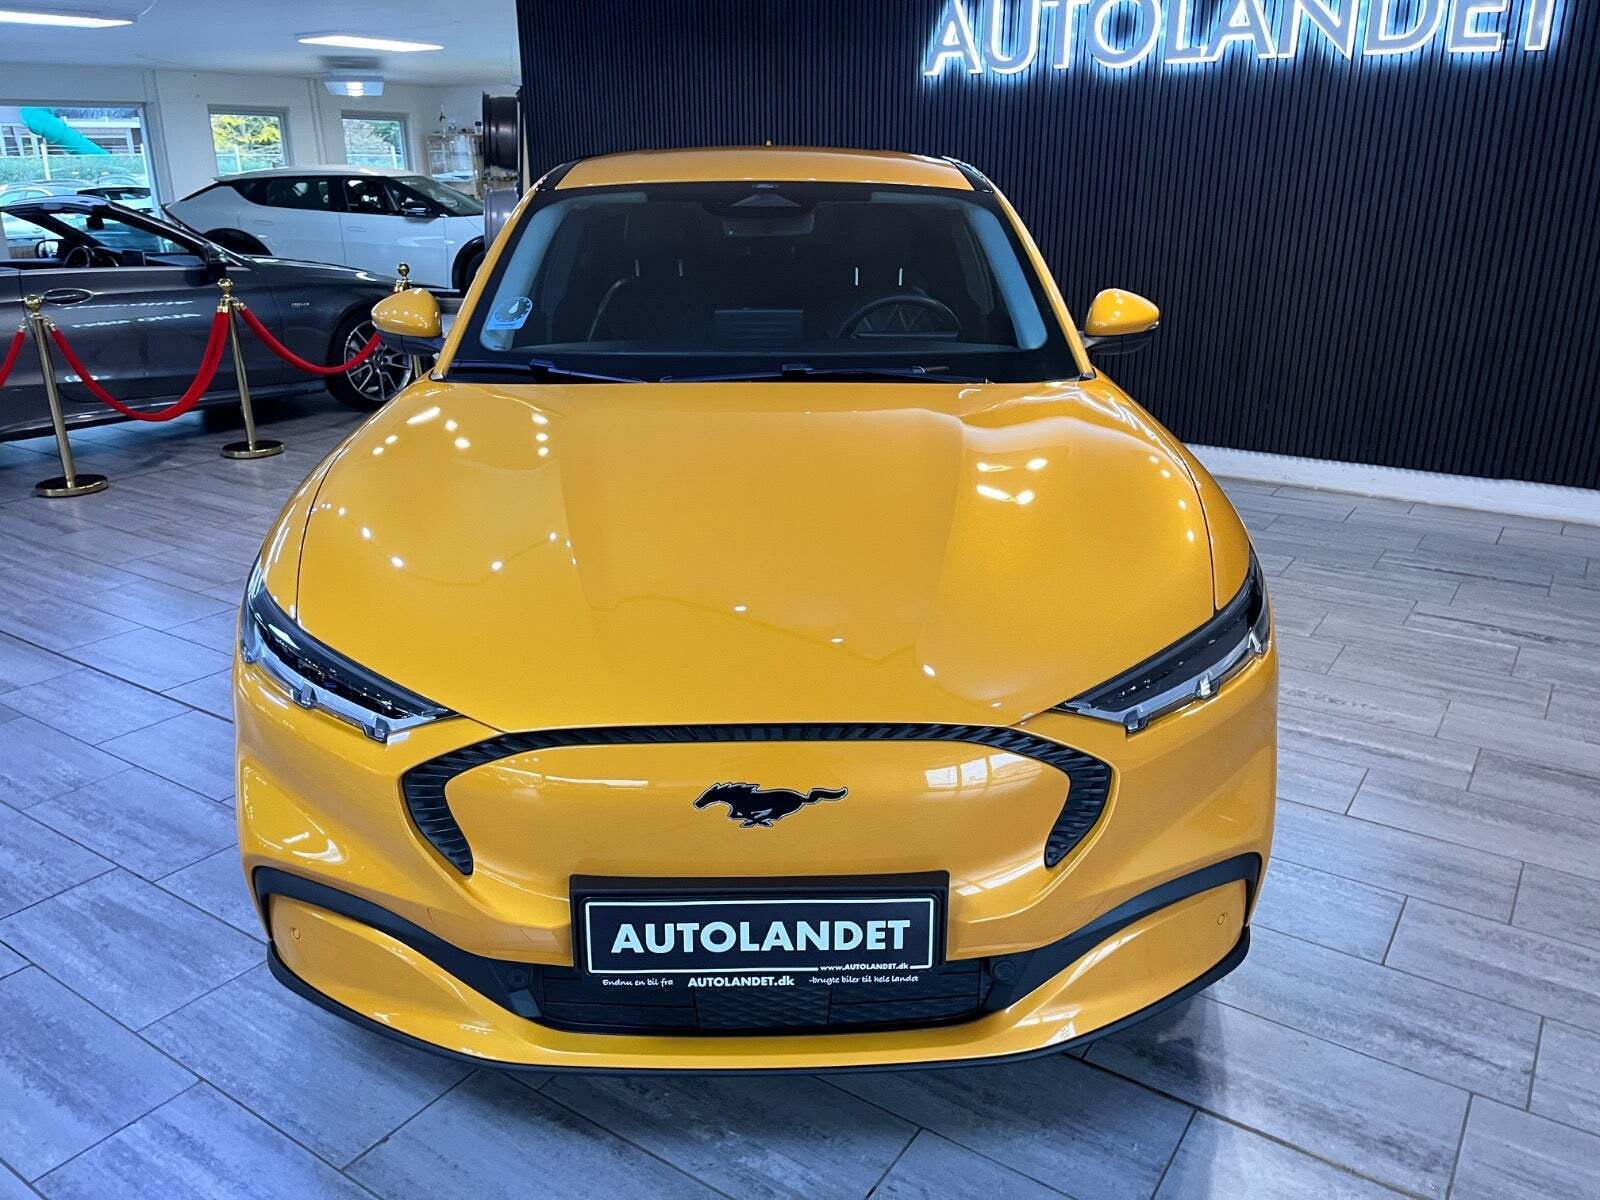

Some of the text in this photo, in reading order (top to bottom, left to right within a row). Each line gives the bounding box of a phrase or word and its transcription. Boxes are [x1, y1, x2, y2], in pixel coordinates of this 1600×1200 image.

[611, 920, 910, 953] AUTOLANDET
[820, 963, 909, 971] www.AUTOLANDET.dk
[647, 978, 659, 986] bil
[660, 978, 673, 987] fra
[688, 976, 795, 987] AUTOLANDET.dk
[861, 975, 872, 983] til
